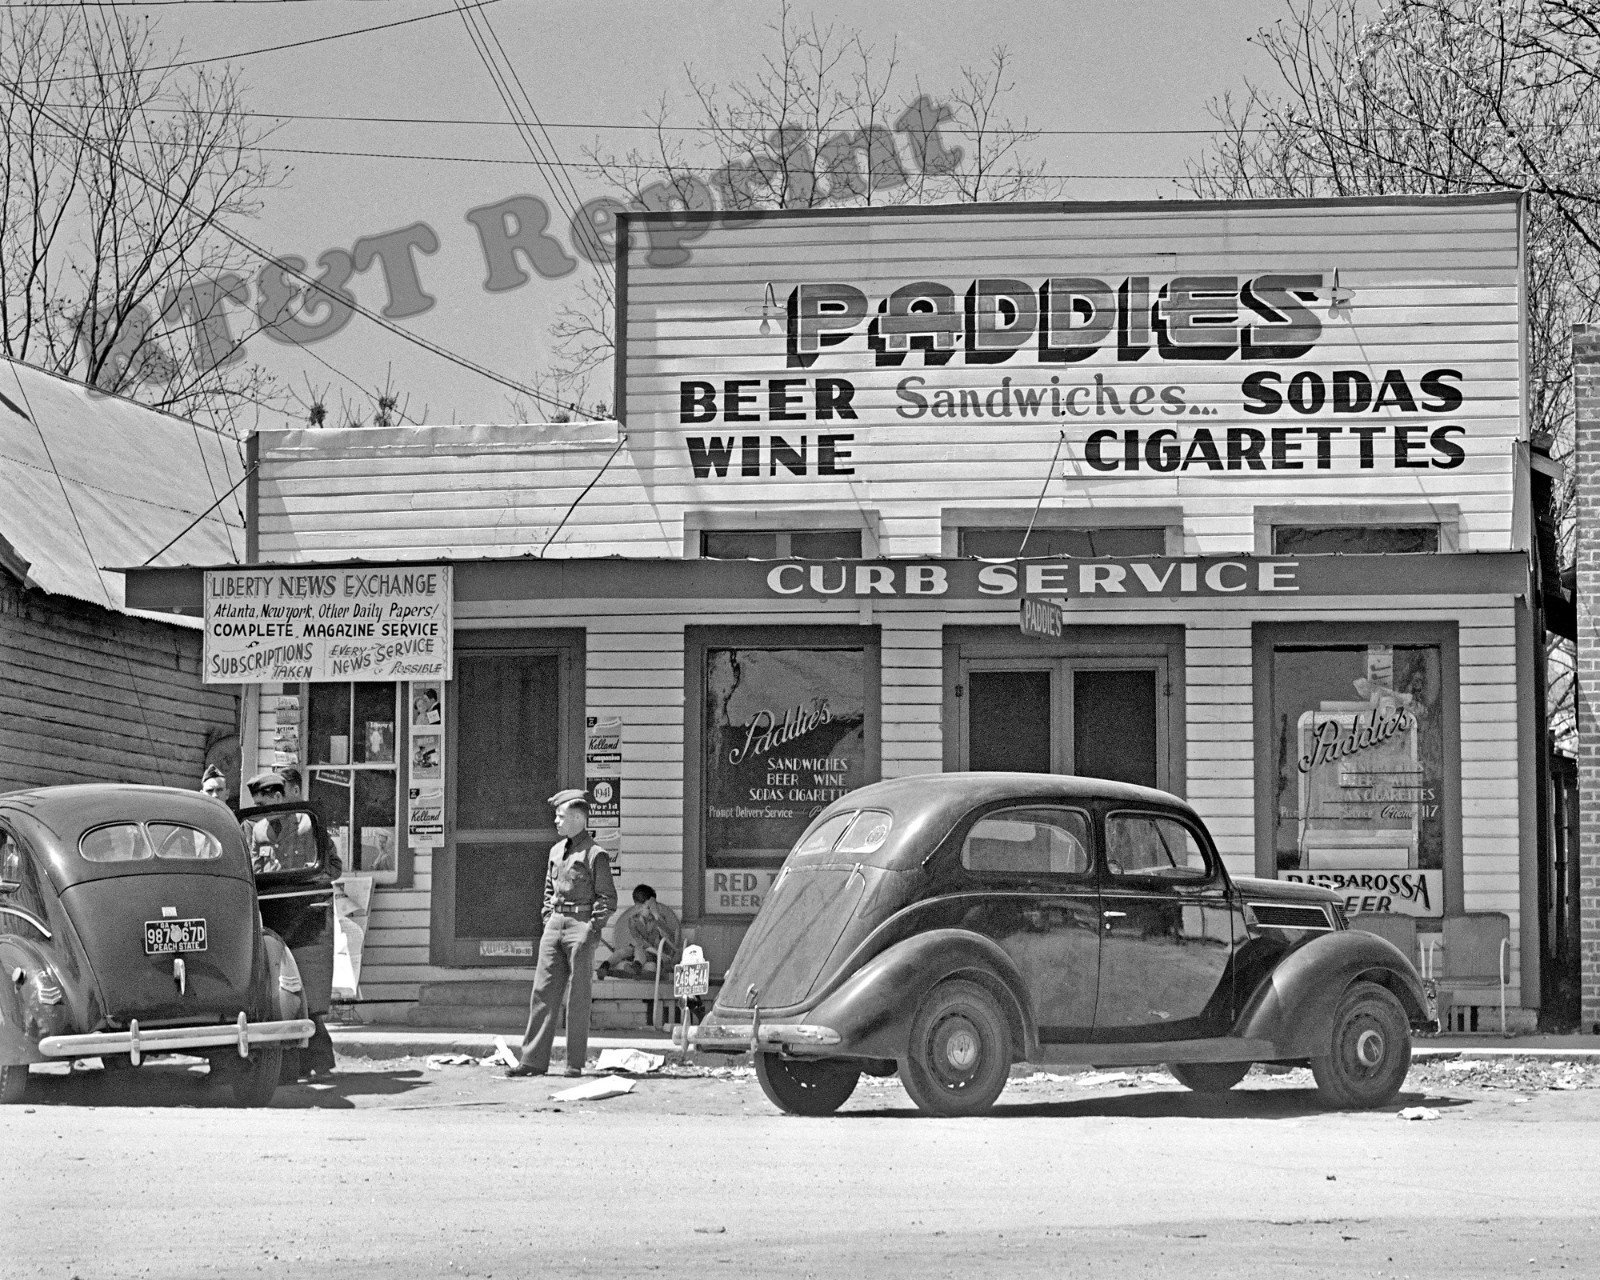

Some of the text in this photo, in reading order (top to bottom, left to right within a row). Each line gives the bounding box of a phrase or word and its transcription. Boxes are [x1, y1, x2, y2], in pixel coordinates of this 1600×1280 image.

[787, 273, 1323, 368] PADDIES
[680, 378, 859, 424] BEER
[1243, 370, 1463, 415] SODAS
[687, 425, 1466, 478] WINE CIGARETTES
[212, 573, 438, 598] LIBERTY NEWS EXCHANGE
[767, 561, 1301, 596] CURB SERVICE
[318, 603, 350, 619] Other
[352, 602, 383, 623] Daily
[302, 622, 376, 638] MAGAZINE
[381, 622, 439, 637] SERVICE
[212, 642, 314, 676] SUBSCRIPTIONS
[329, 645, 368, 658] EVERY
[332, 638, 436, 677] NEWS SERVICE
[272, 660, 443, 680] TAKEN POSSIBLE
[767, 757, 848, 771] SANDWICHES
[766, 773, 847, 787] BEER WINE
[749, 788, 850, 801] SODAS CIGARETT
[590, 803, 618, 811] World
[765, 806, 793, 818] Service
[1421, 804, 1439, 818] 117
[713, 873, 758, 892] RED
[720, 895, 761, 907] BEER
[1344, 895, 1392, 912] EER
[153, 941, 200, 951] PEACH STATE
